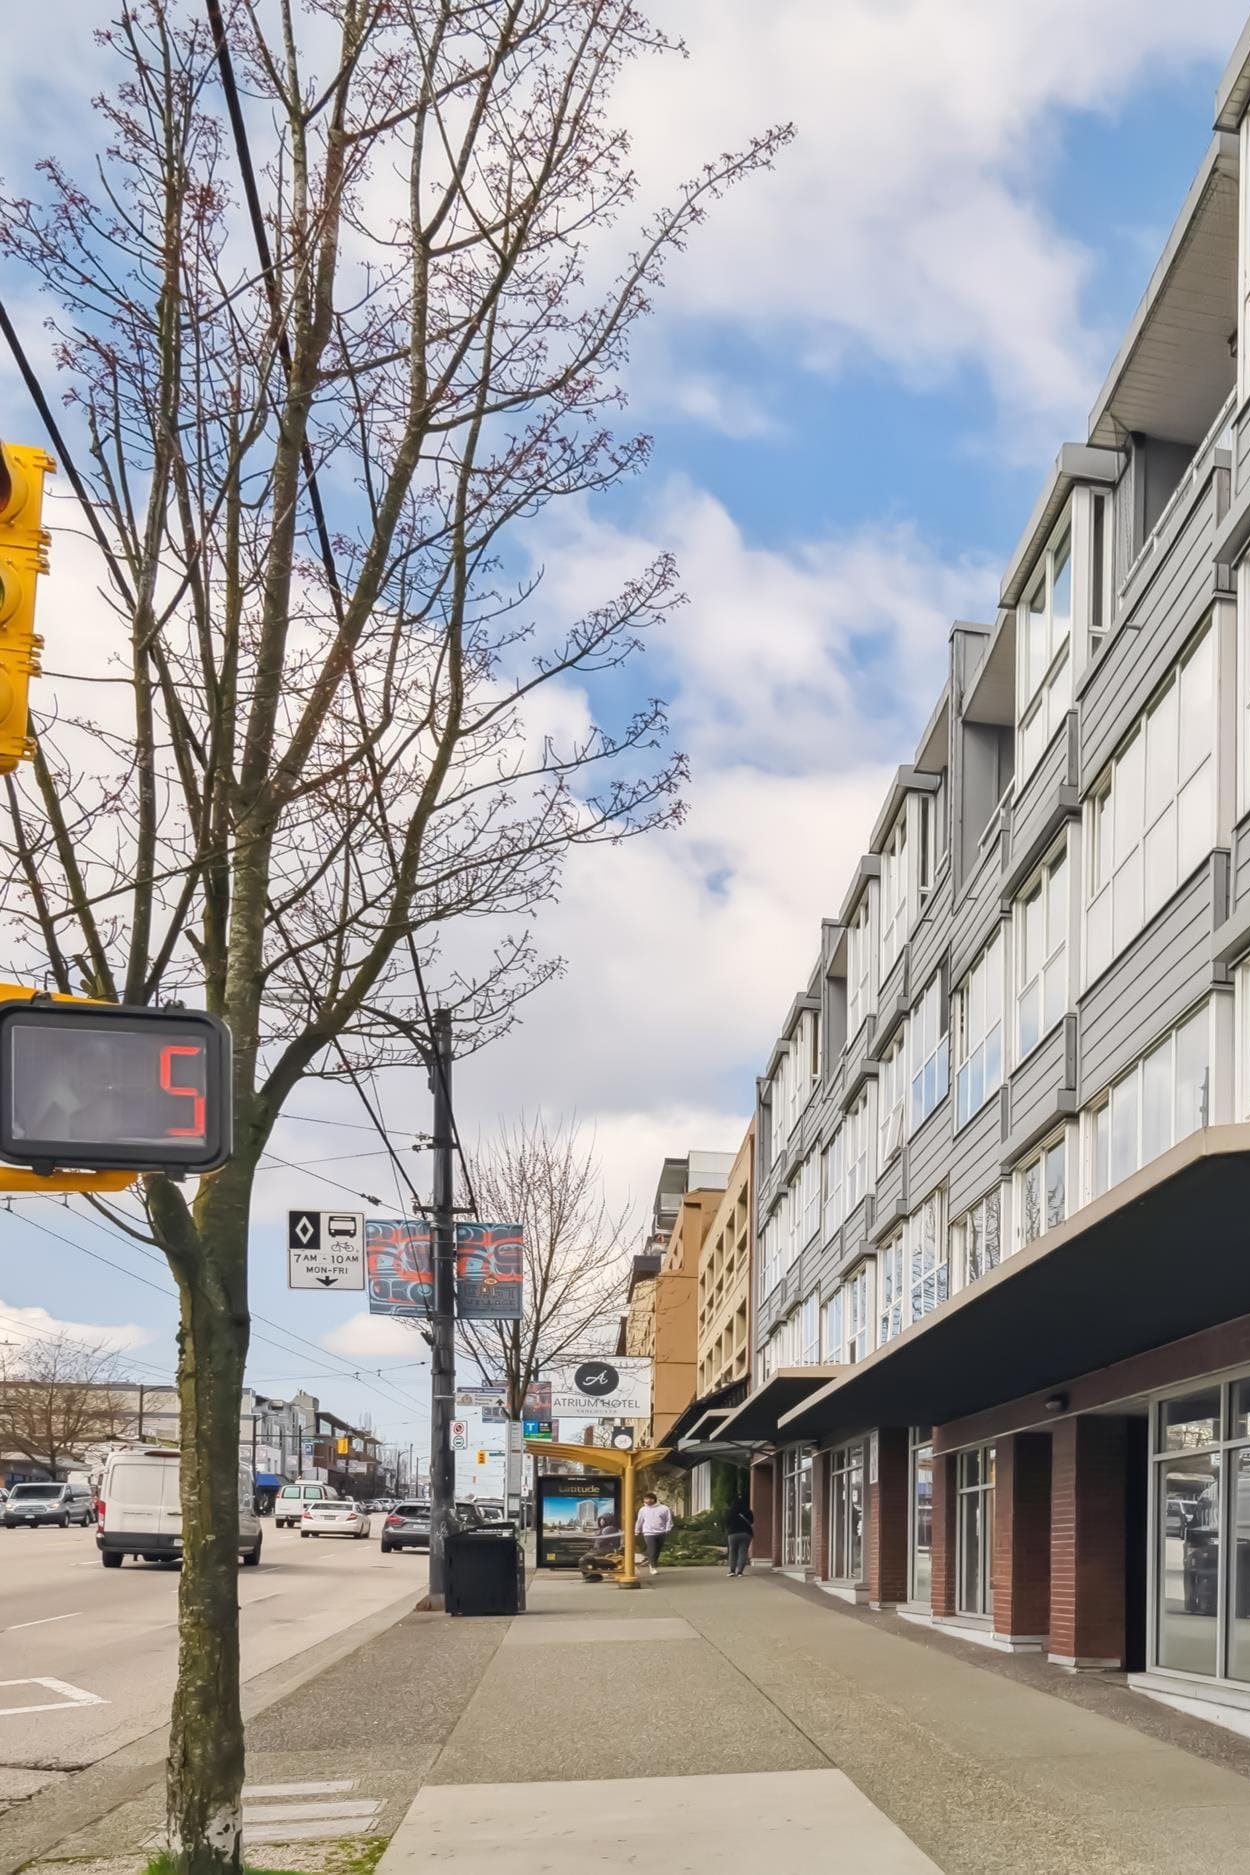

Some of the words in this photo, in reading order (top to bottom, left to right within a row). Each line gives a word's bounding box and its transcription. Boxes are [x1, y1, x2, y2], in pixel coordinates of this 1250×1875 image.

[159, 1045, 206, 1137] 5
[305, 1266, 348, 1275] MON-FRI
[553, 1398, 597, 1407] ATRIUM
[602, 1399, 640, 1409] HOTEL
